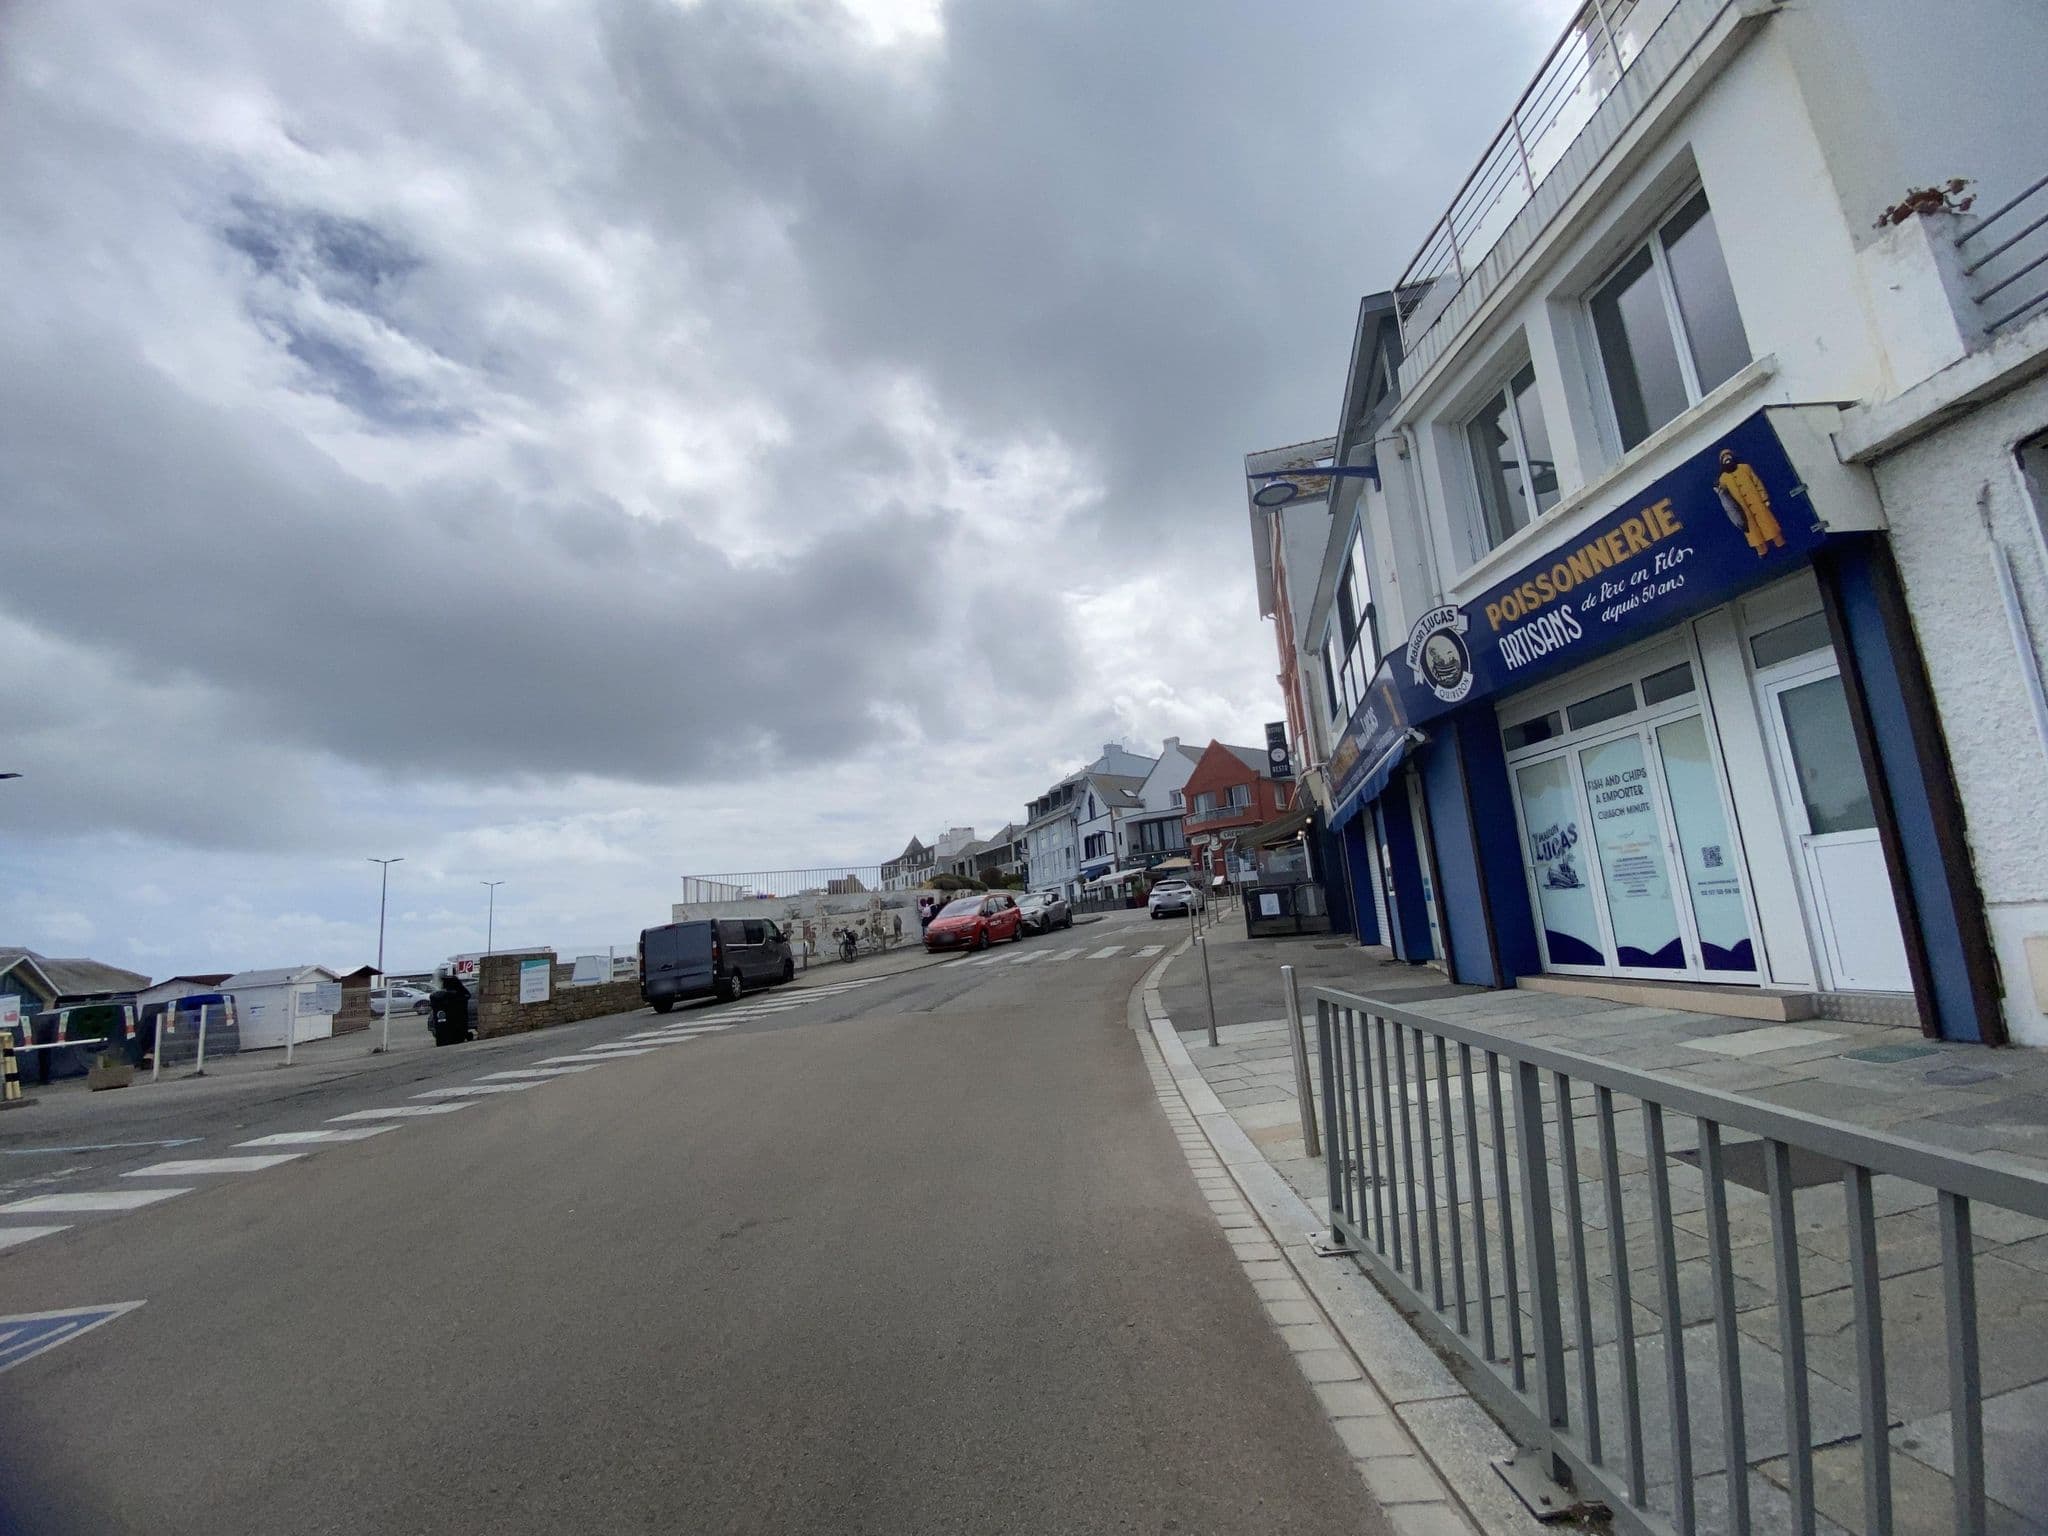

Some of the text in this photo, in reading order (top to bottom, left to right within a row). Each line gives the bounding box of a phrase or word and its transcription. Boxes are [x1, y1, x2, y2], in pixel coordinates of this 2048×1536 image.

[1485, 498, 1683, 631] POISSONNERIE
[1581, 546, 1694, 612] de Père en Fils
[1601, 574, 1685, 623] depuis 50 ans
[1410, 609, 1454, 665] Maison LUCAS
[1499, 604, 1582, 671] ARTISANS
[1588, 768, 1647, 791] FISH AND CHIPS
[1596, 784, 1644, 804] A EMPORTER
[1627, 802, 1650, 814] MINUTE
[1536, 822, 1578, 861] LUCAS
